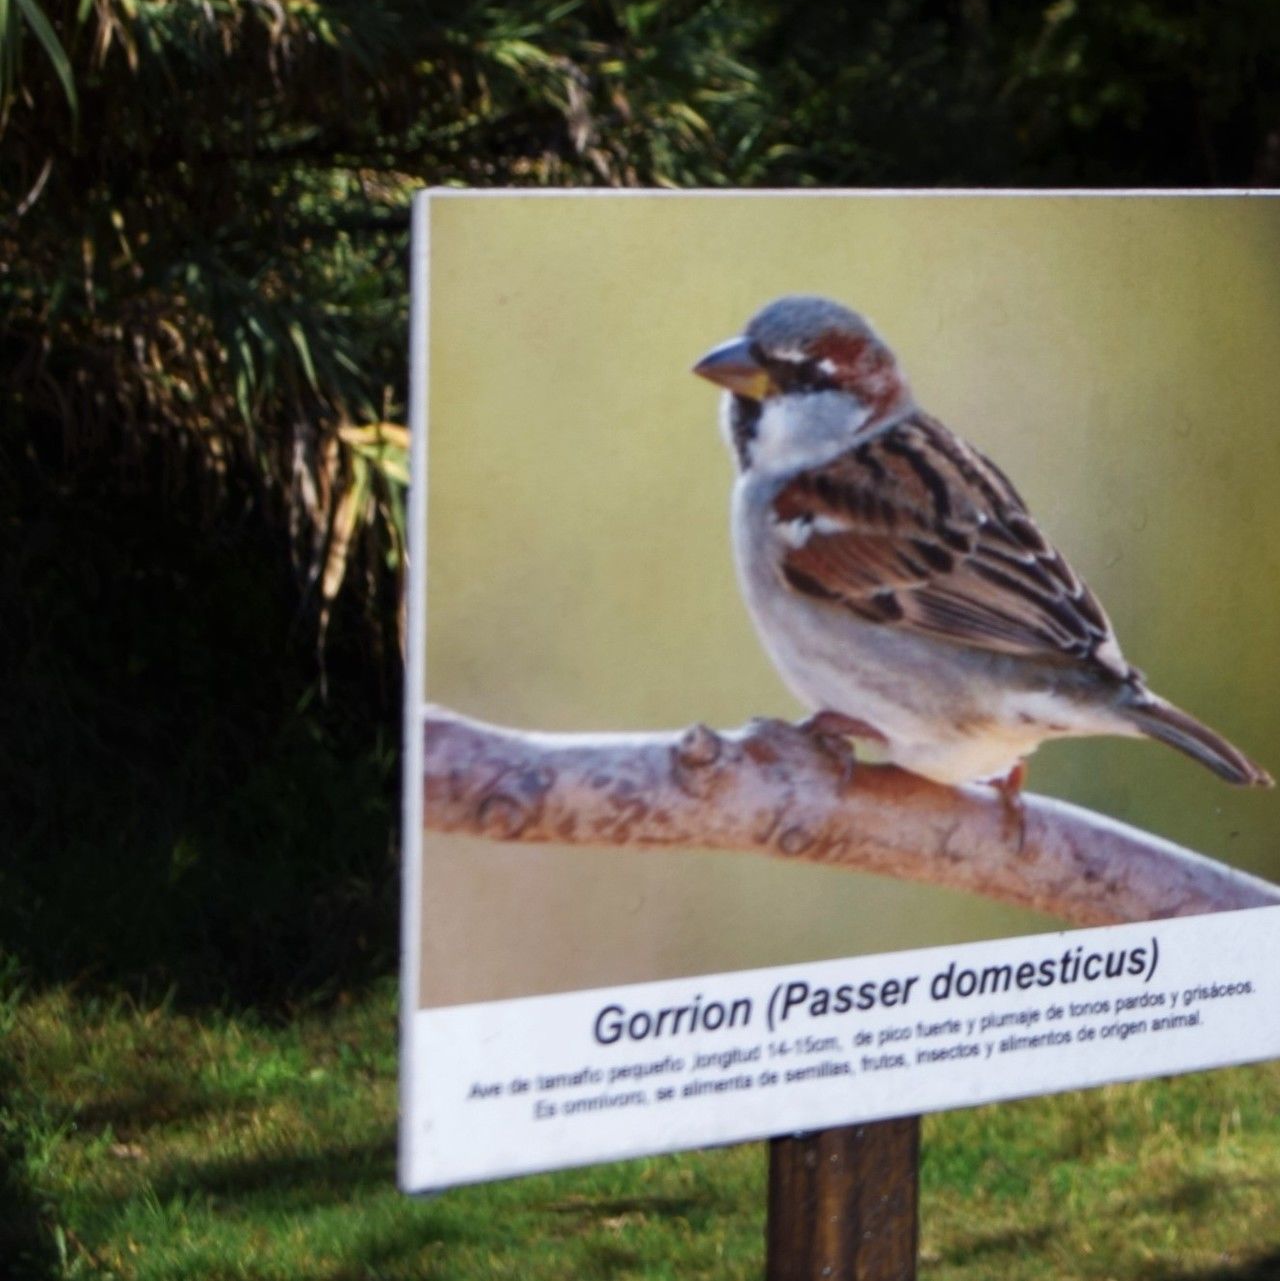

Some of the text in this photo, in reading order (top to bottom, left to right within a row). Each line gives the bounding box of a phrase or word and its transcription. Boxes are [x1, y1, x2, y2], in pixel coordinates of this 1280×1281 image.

[467, 1082, 504, 1100] Ave
[507, 1078, 531, 1096] de
[607, 1055, 685, 1086] pequeño
[853, 1029, 875, 1047] de
[878, 1026, 913, 1048] pico
[915, 1019, 962, 1039] fuerte
[967, 1019, 977, 1036] y
[979, 1009, 1041, 1034] plumaje
[1045, 1003, 1066, 1021] de
[1069, 999, 1111, 1018] tonos
[1114, 991, 1166, 1017] pardos
[1170, 991, 1180, 1009] y
[1182, 980, 1256, 1007] grisáceos.
[592, 936, 1159, 1047] Gorrion (Passer domesticus)
[655, 1086, 676, 1103] se
[680, 1074, 754, 1100] alimenta
[757, 1070, 779, 1089] de
[784, 1061, 855, 1085] semillas,
[860, 1053, 910, 1073] frutos,
[915, 1042, 981, 1065] insectos
[985, 1042, 995, 1059] y
[998, 1029, 1073, 1054] alimentos
[1076, 1024, 1097, 1042] de
[1099, 1019, 1147, 1042] origen
[1151, 1010, 1206, 1032] animal.
